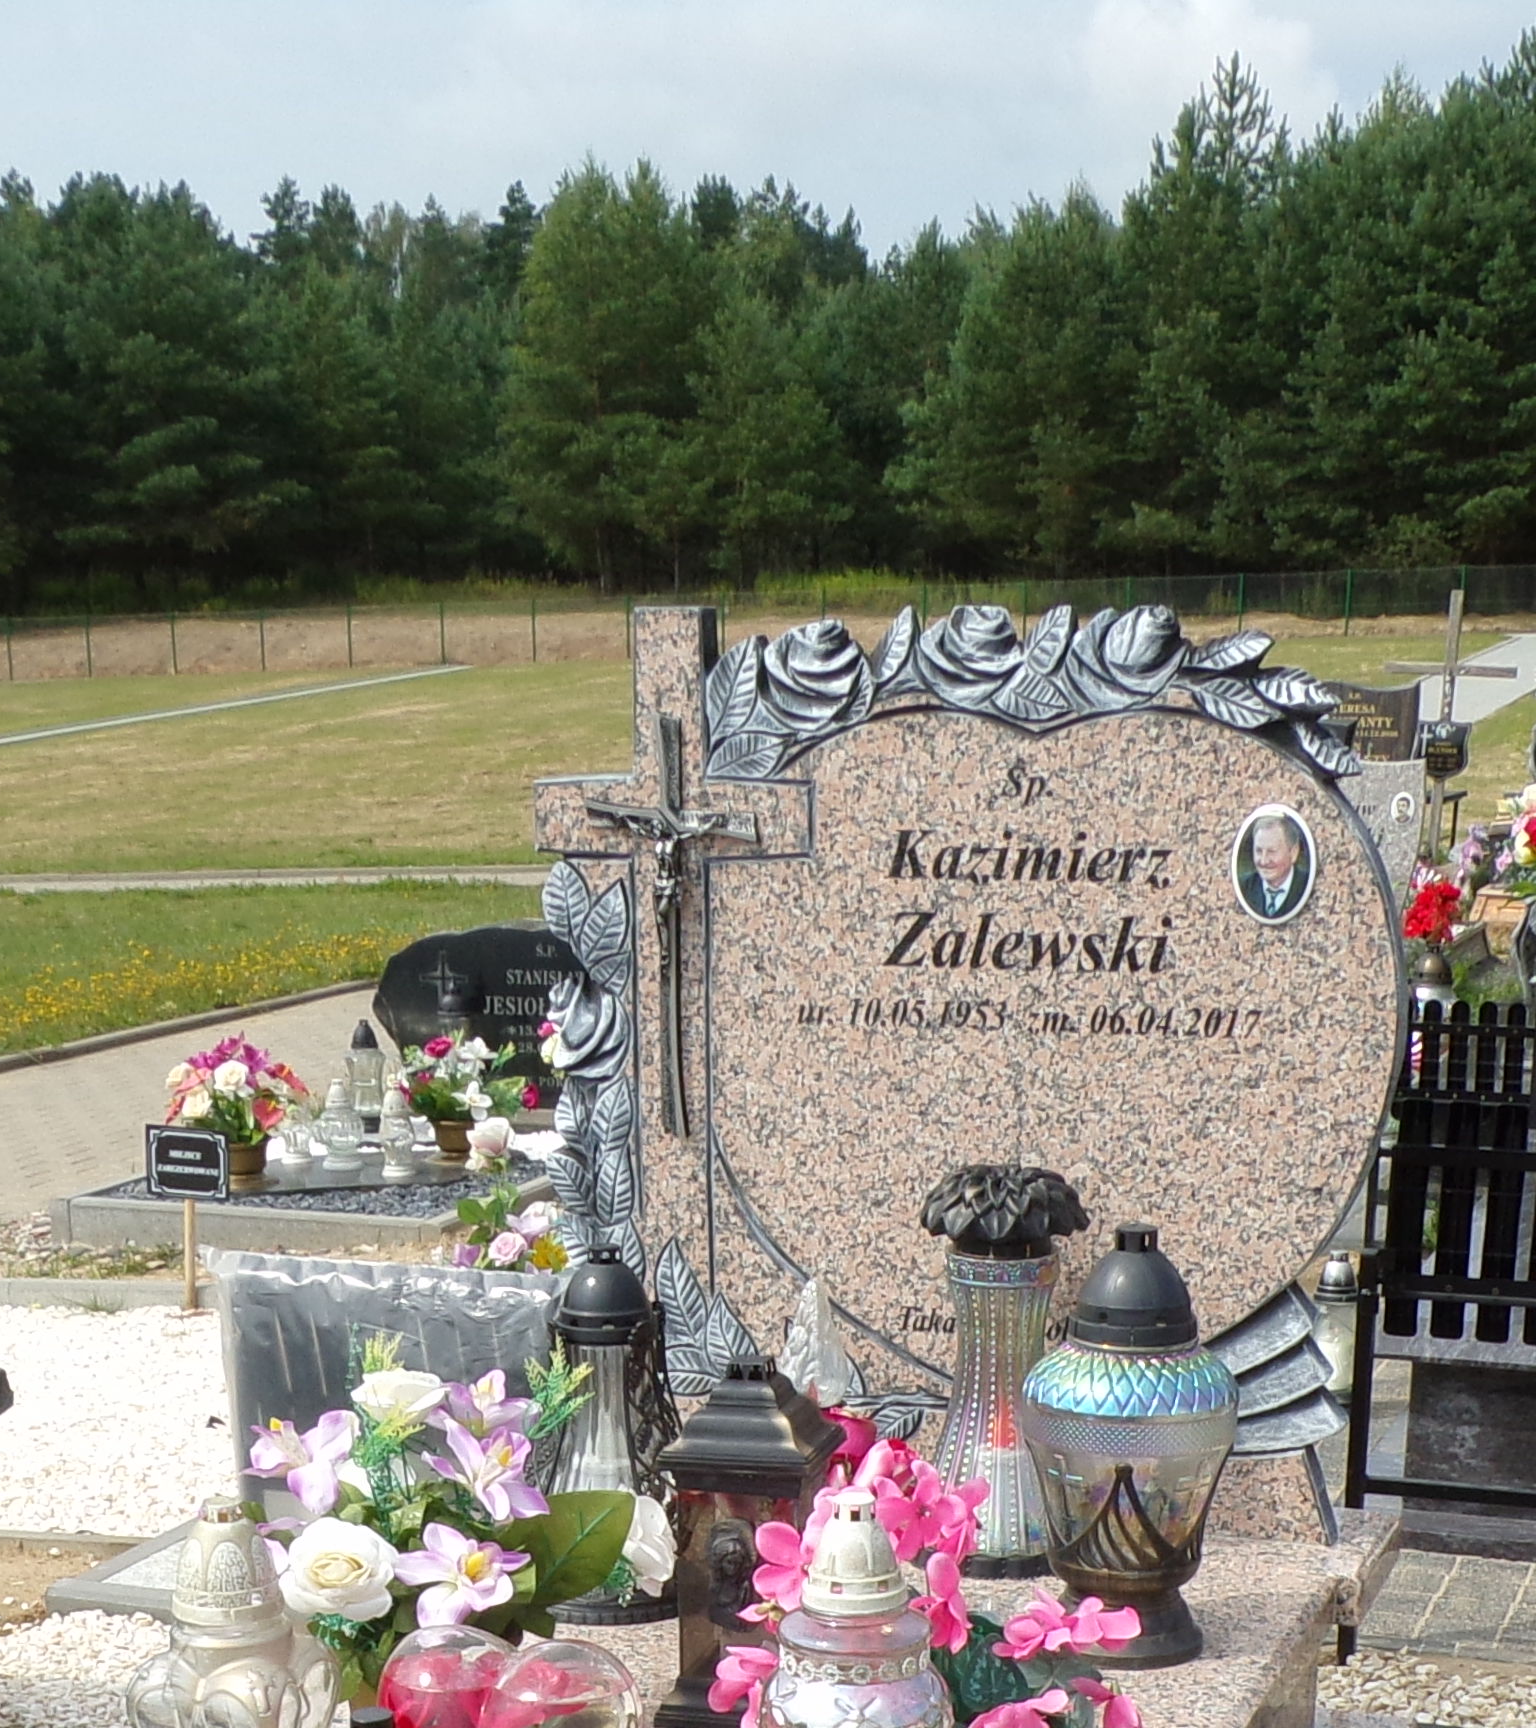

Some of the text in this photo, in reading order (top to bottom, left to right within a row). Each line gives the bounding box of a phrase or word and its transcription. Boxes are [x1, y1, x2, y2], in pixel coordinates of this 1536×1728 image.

[1338, 703, 1376, 714] ERESA
[887, 827, 1174, 889] Kazimierz
[883, 911, 1174, 975] Zalewski
[483, 995, 547, 1016] JESIOŁ
[1089, 1003, 1264, 1039] 06.04.2017
[898, 1304, 957, 1335] Taka
